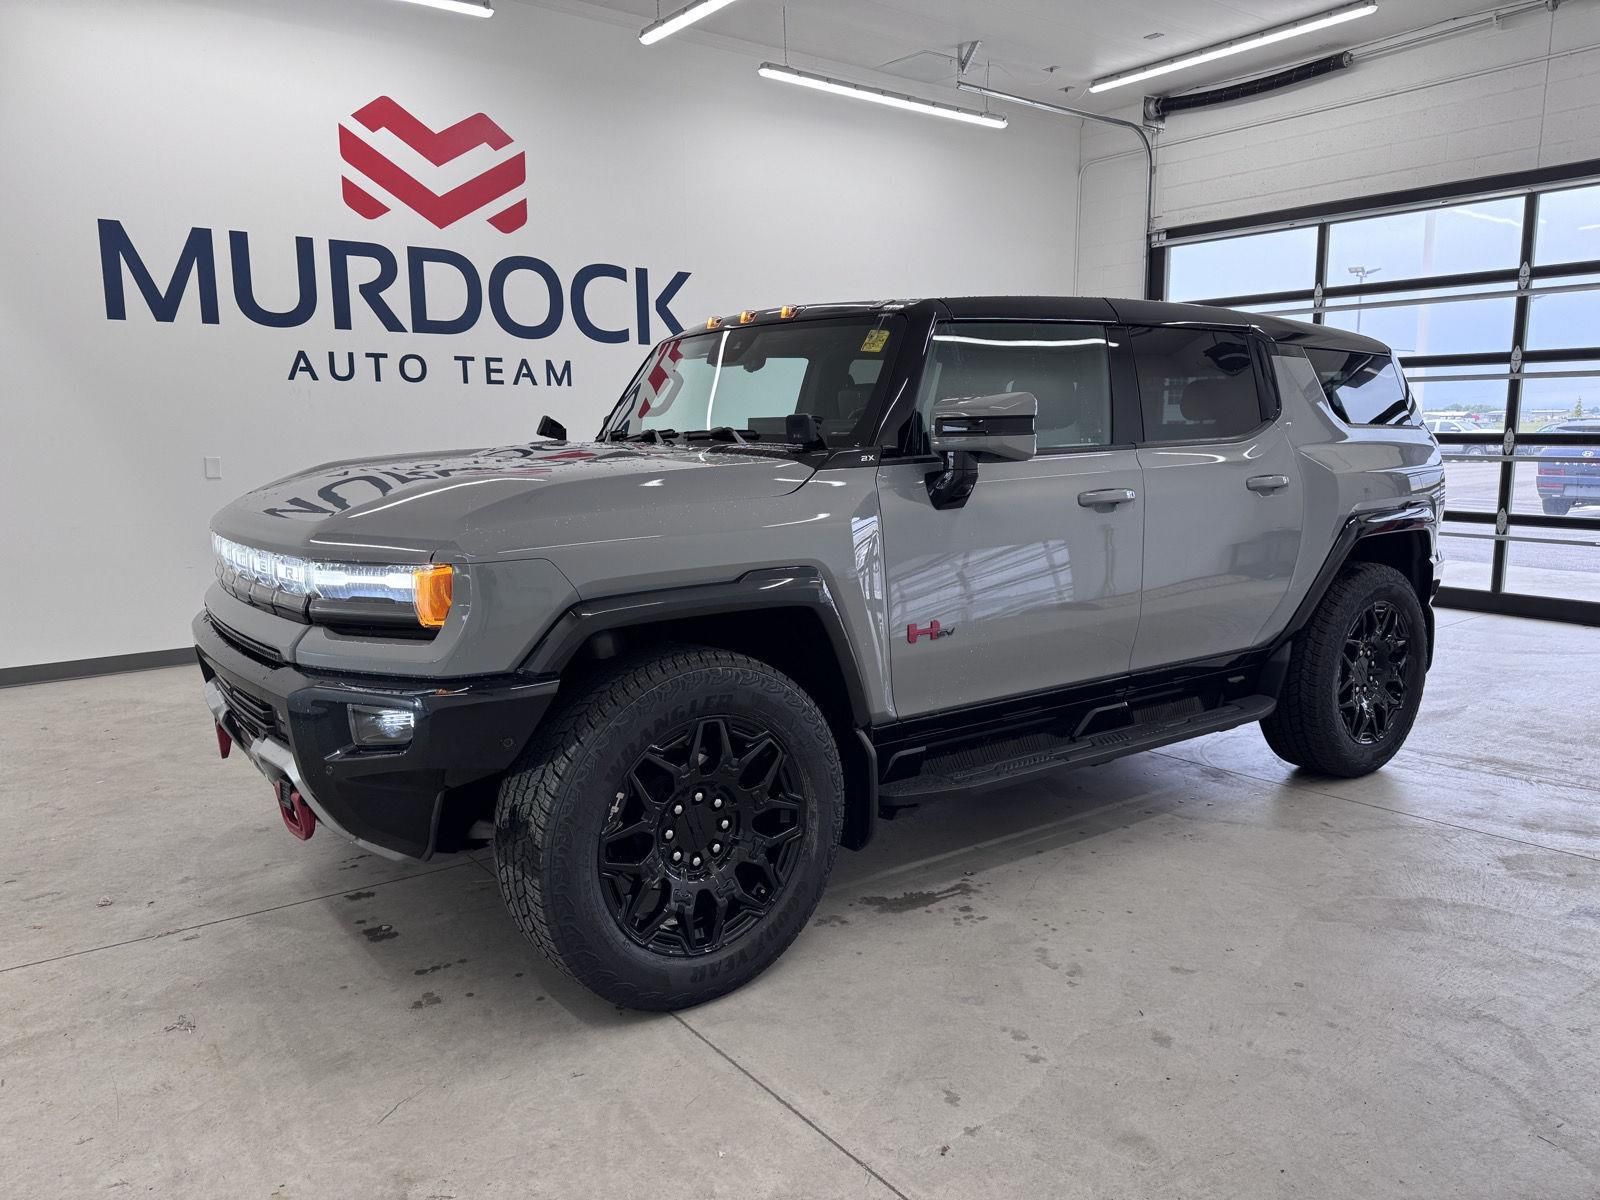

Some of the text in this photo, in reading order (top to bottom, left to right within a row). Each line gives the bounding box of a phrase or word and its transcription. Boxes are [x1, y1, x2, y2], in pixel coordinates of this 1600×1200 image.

[98, 218, 692, 345] MURDOCK
[287, 350, 573, 387] AUTO TEAM
[860, 454, 875, 462] 2X
